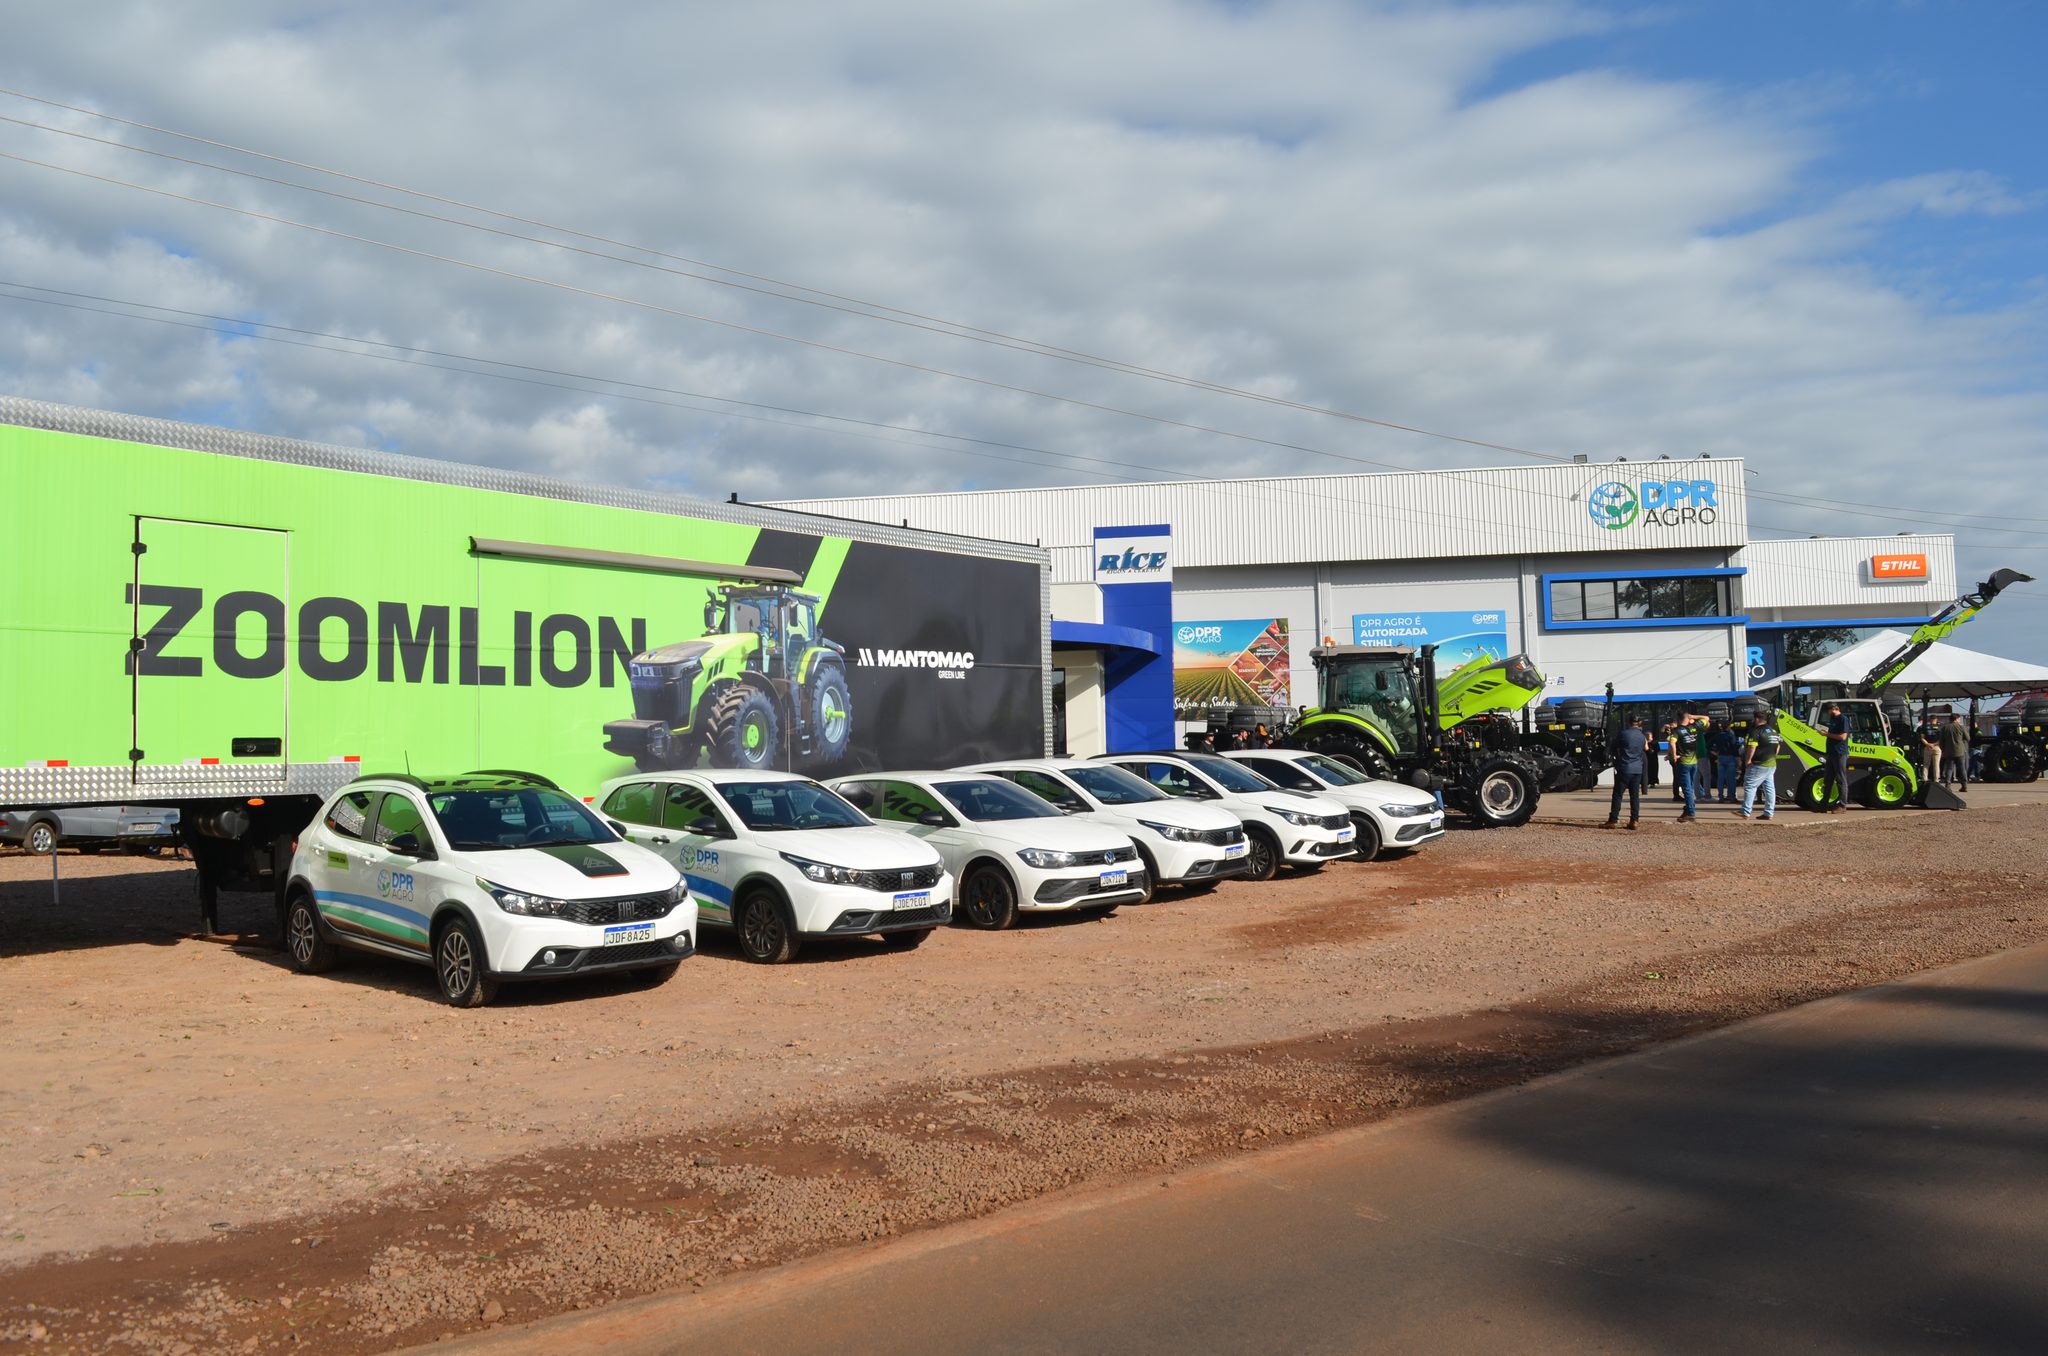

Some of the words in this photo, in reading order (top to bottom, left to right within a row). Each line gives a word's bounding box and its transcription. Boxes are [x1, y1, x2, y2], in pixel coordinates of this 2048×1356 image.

[1640, 479, 1718, 509] DPR
[1643, 507, 1716, 527] AGRO
[1880, 560, 1921, 571] STIHL
[1360, 619, 1382, 628] DPR
[1383, 617, 1413, 627] AGRO
[125, 583, 647, 688] ZOOMLION
[1195, 626, 1221, 638] DPR
[1360, 627, 1428, 638] AUTORIZADA
[877, 649, 975, 669] MANTOMAC
[938, 670, 955, 679] GREEN
[955, 671, 965, 679] LINE
[1872, 662, 1906, 689] ZOOMLION
[1847, 745, 1875, 755] MLION
[697, 849, 719, 864] DPR
[391, 872, 413, 890] DPR
[392, 889, 414, 901] AGRO
[618, 901, 637, 919] FIAT
[609, 929, 650, 944] JDF8A25
